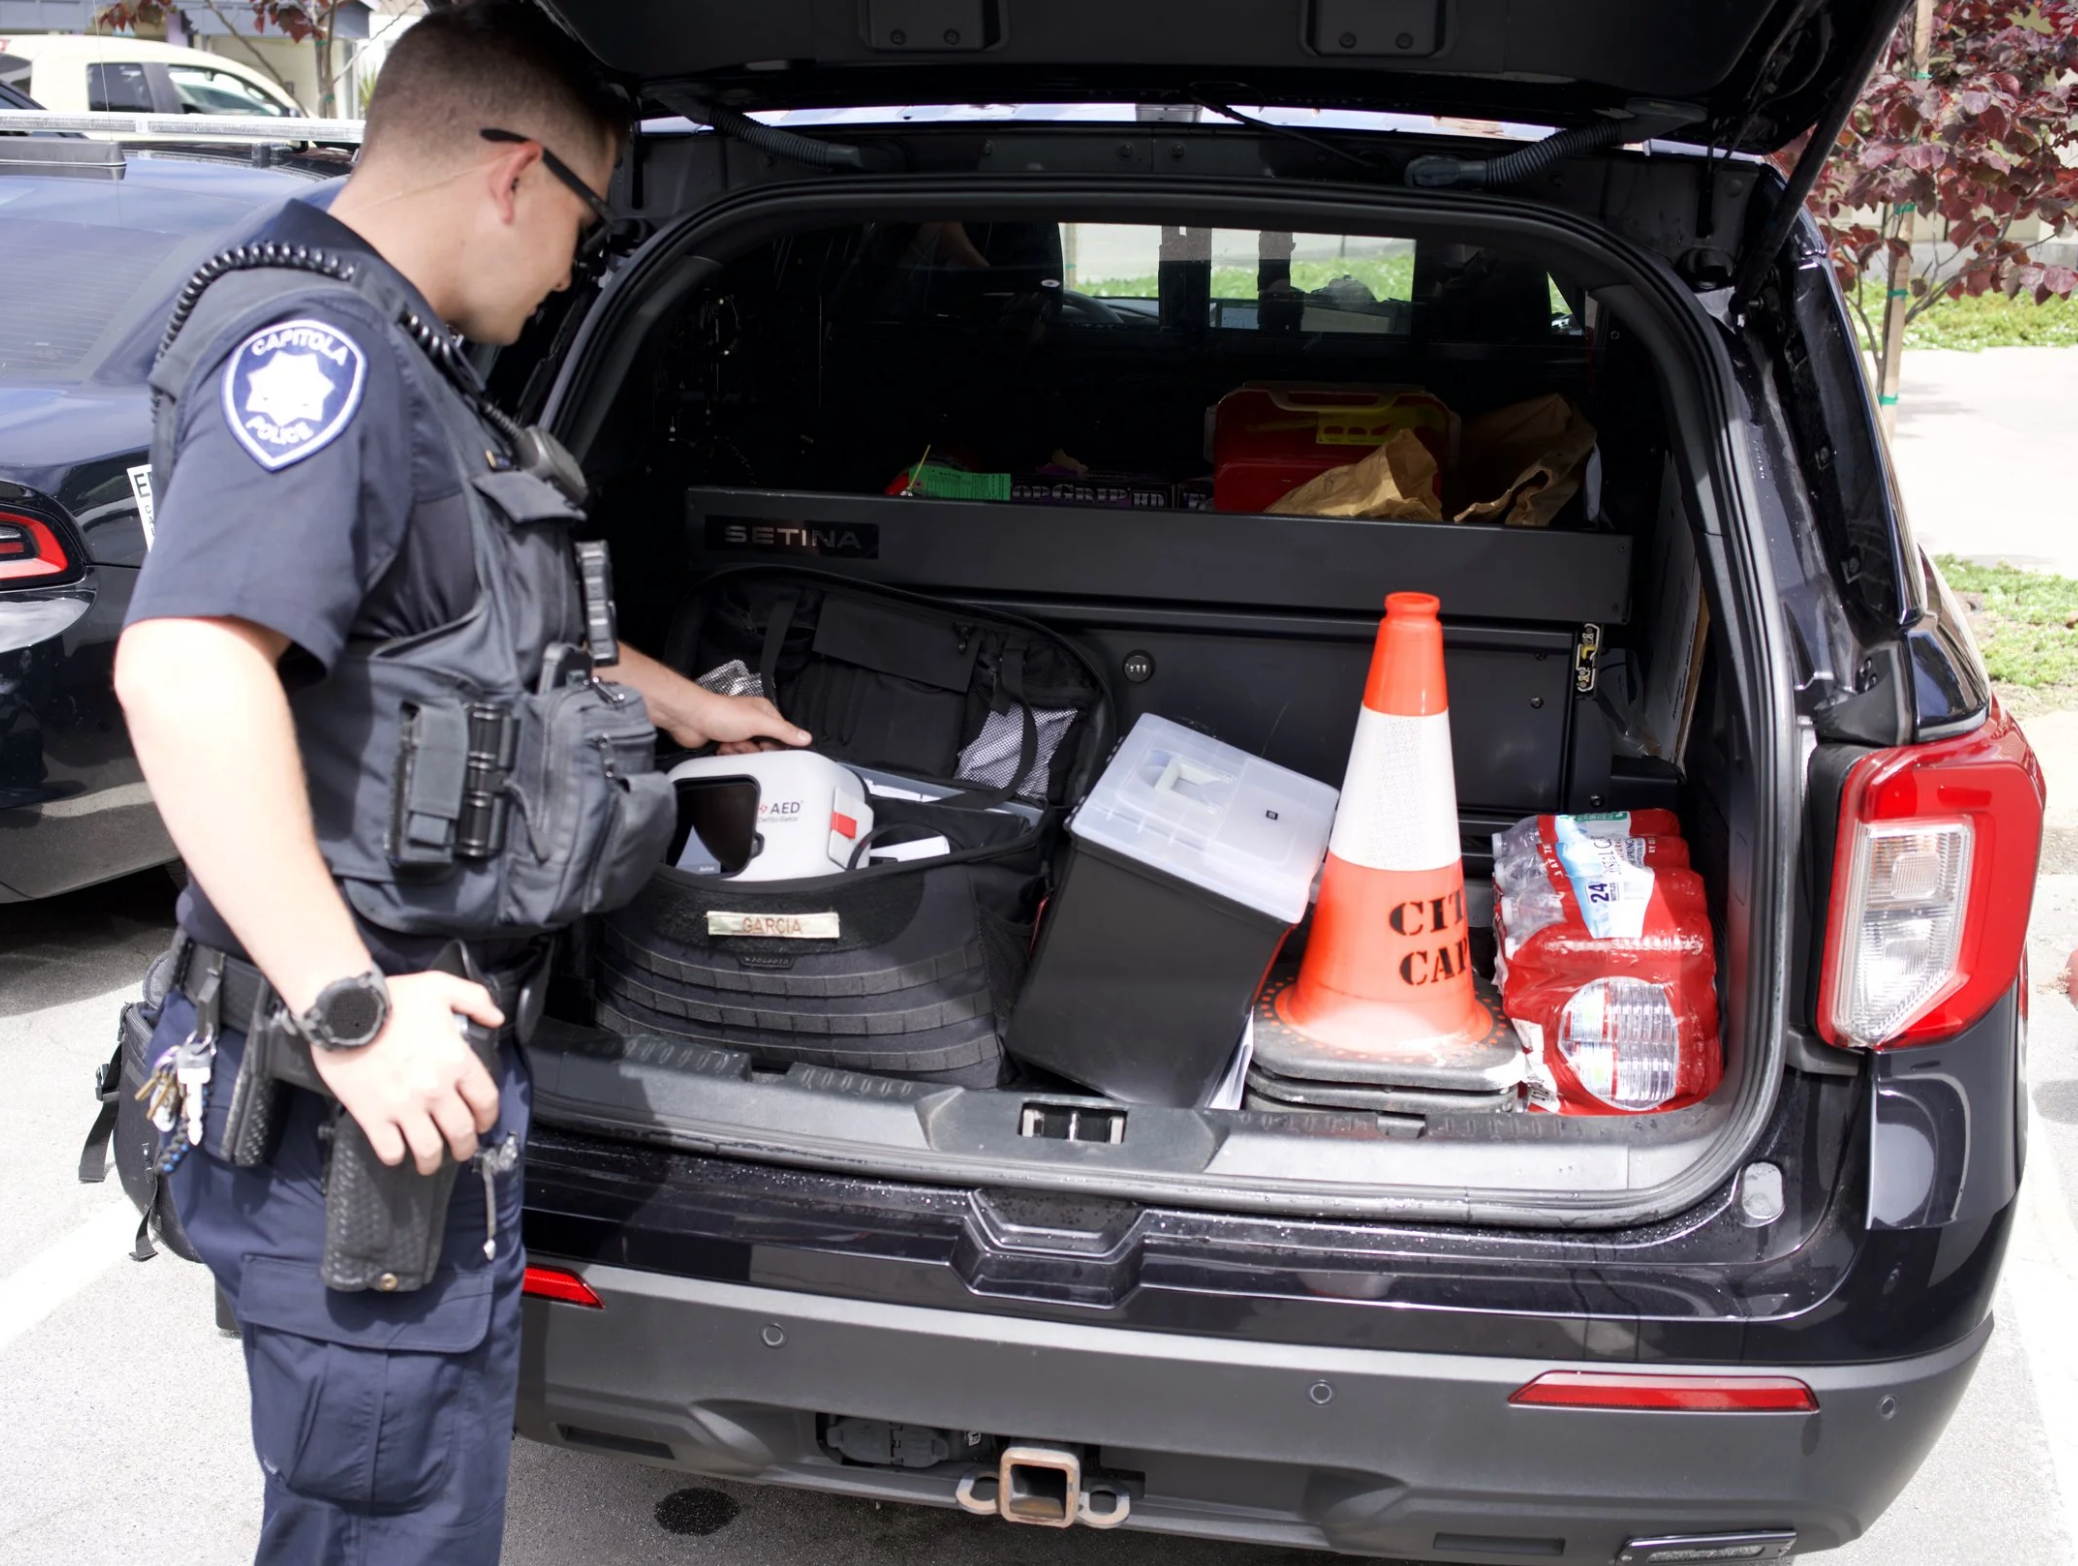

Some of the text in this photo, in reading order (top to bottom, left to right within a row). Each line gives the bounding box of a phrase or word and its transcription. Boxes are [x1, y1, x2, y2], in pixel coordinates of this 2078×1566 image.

[251, 329, 349, 366] CAPITOLA
[245, 416, 314, 445] POLICE
[723, 525, 862, 550] SETINA
[769, 801, 801, 815] AED
[1587, 883, 1609, 904] 24
[742, 917, 803, 934] GARCIA
